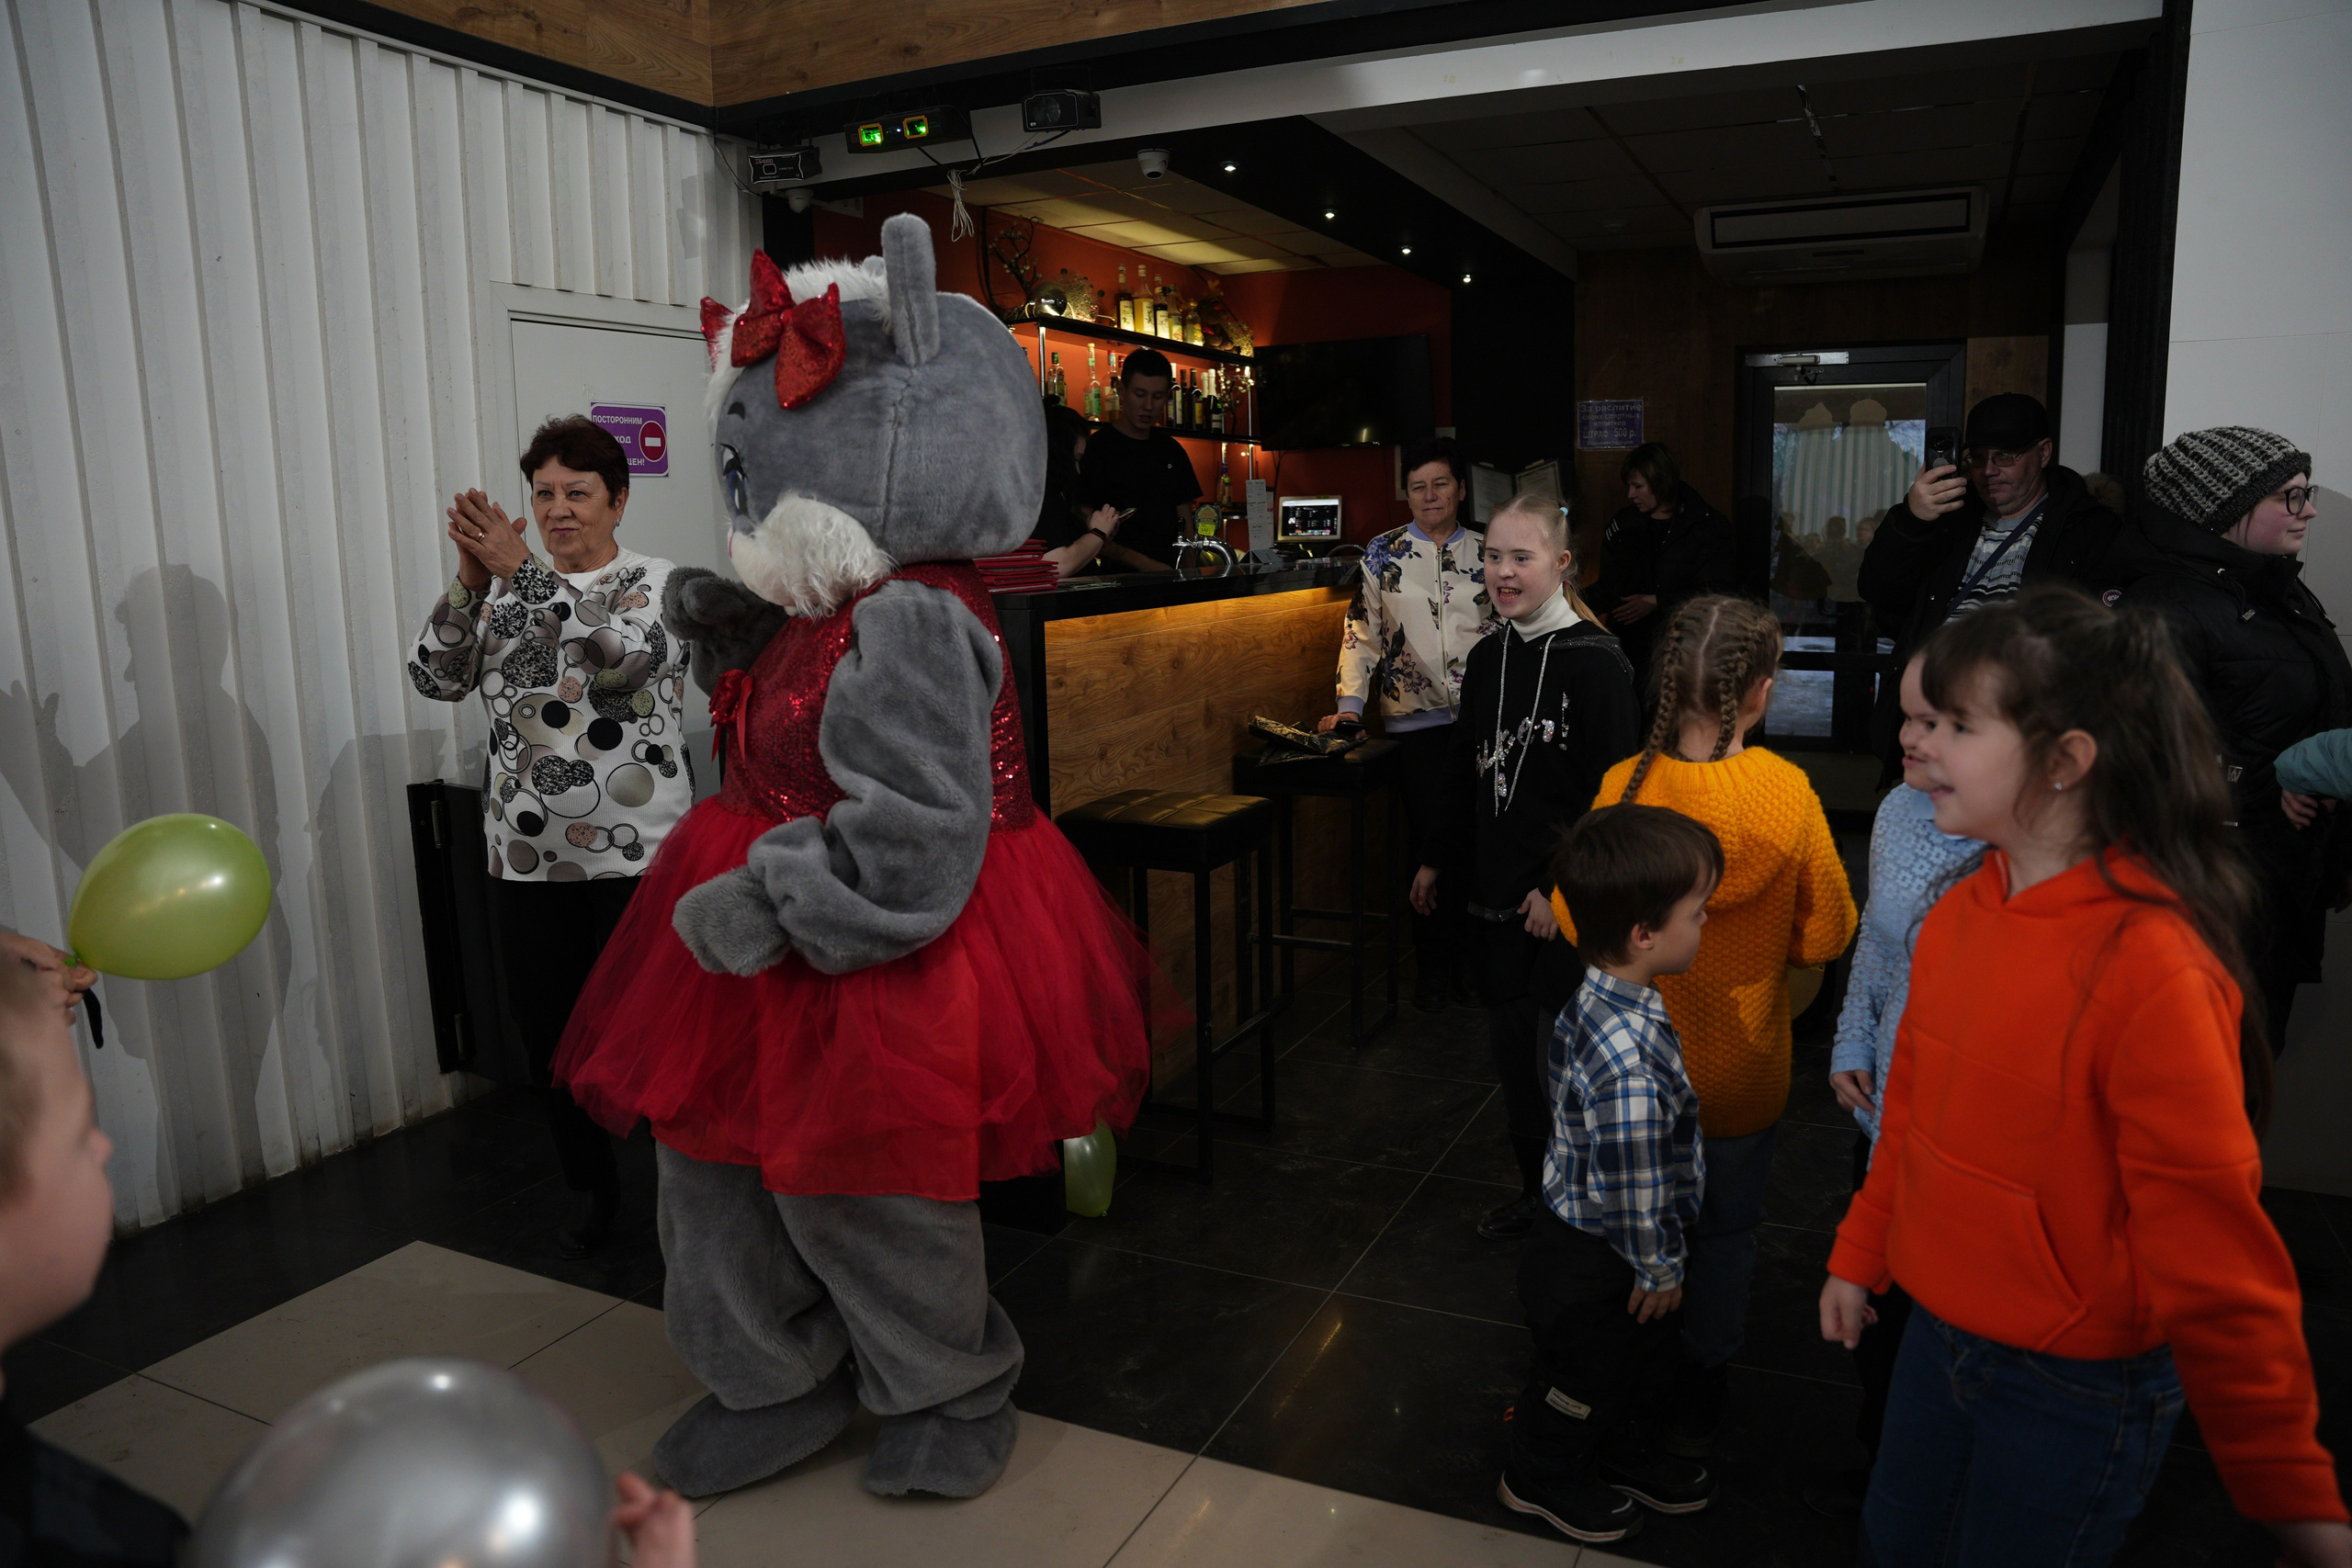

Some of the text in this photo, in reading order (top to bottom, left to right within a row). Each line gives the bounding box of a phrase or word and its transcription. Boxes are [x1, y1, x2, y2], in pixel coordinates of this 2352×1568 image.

[1580, 404, 1642, 413] За распитие
[593, 415, 642, 424] ПОСТОРОННИМ
[1613, 428, 1627, 437] 500
[614, 435, 631, 444] ХОД
